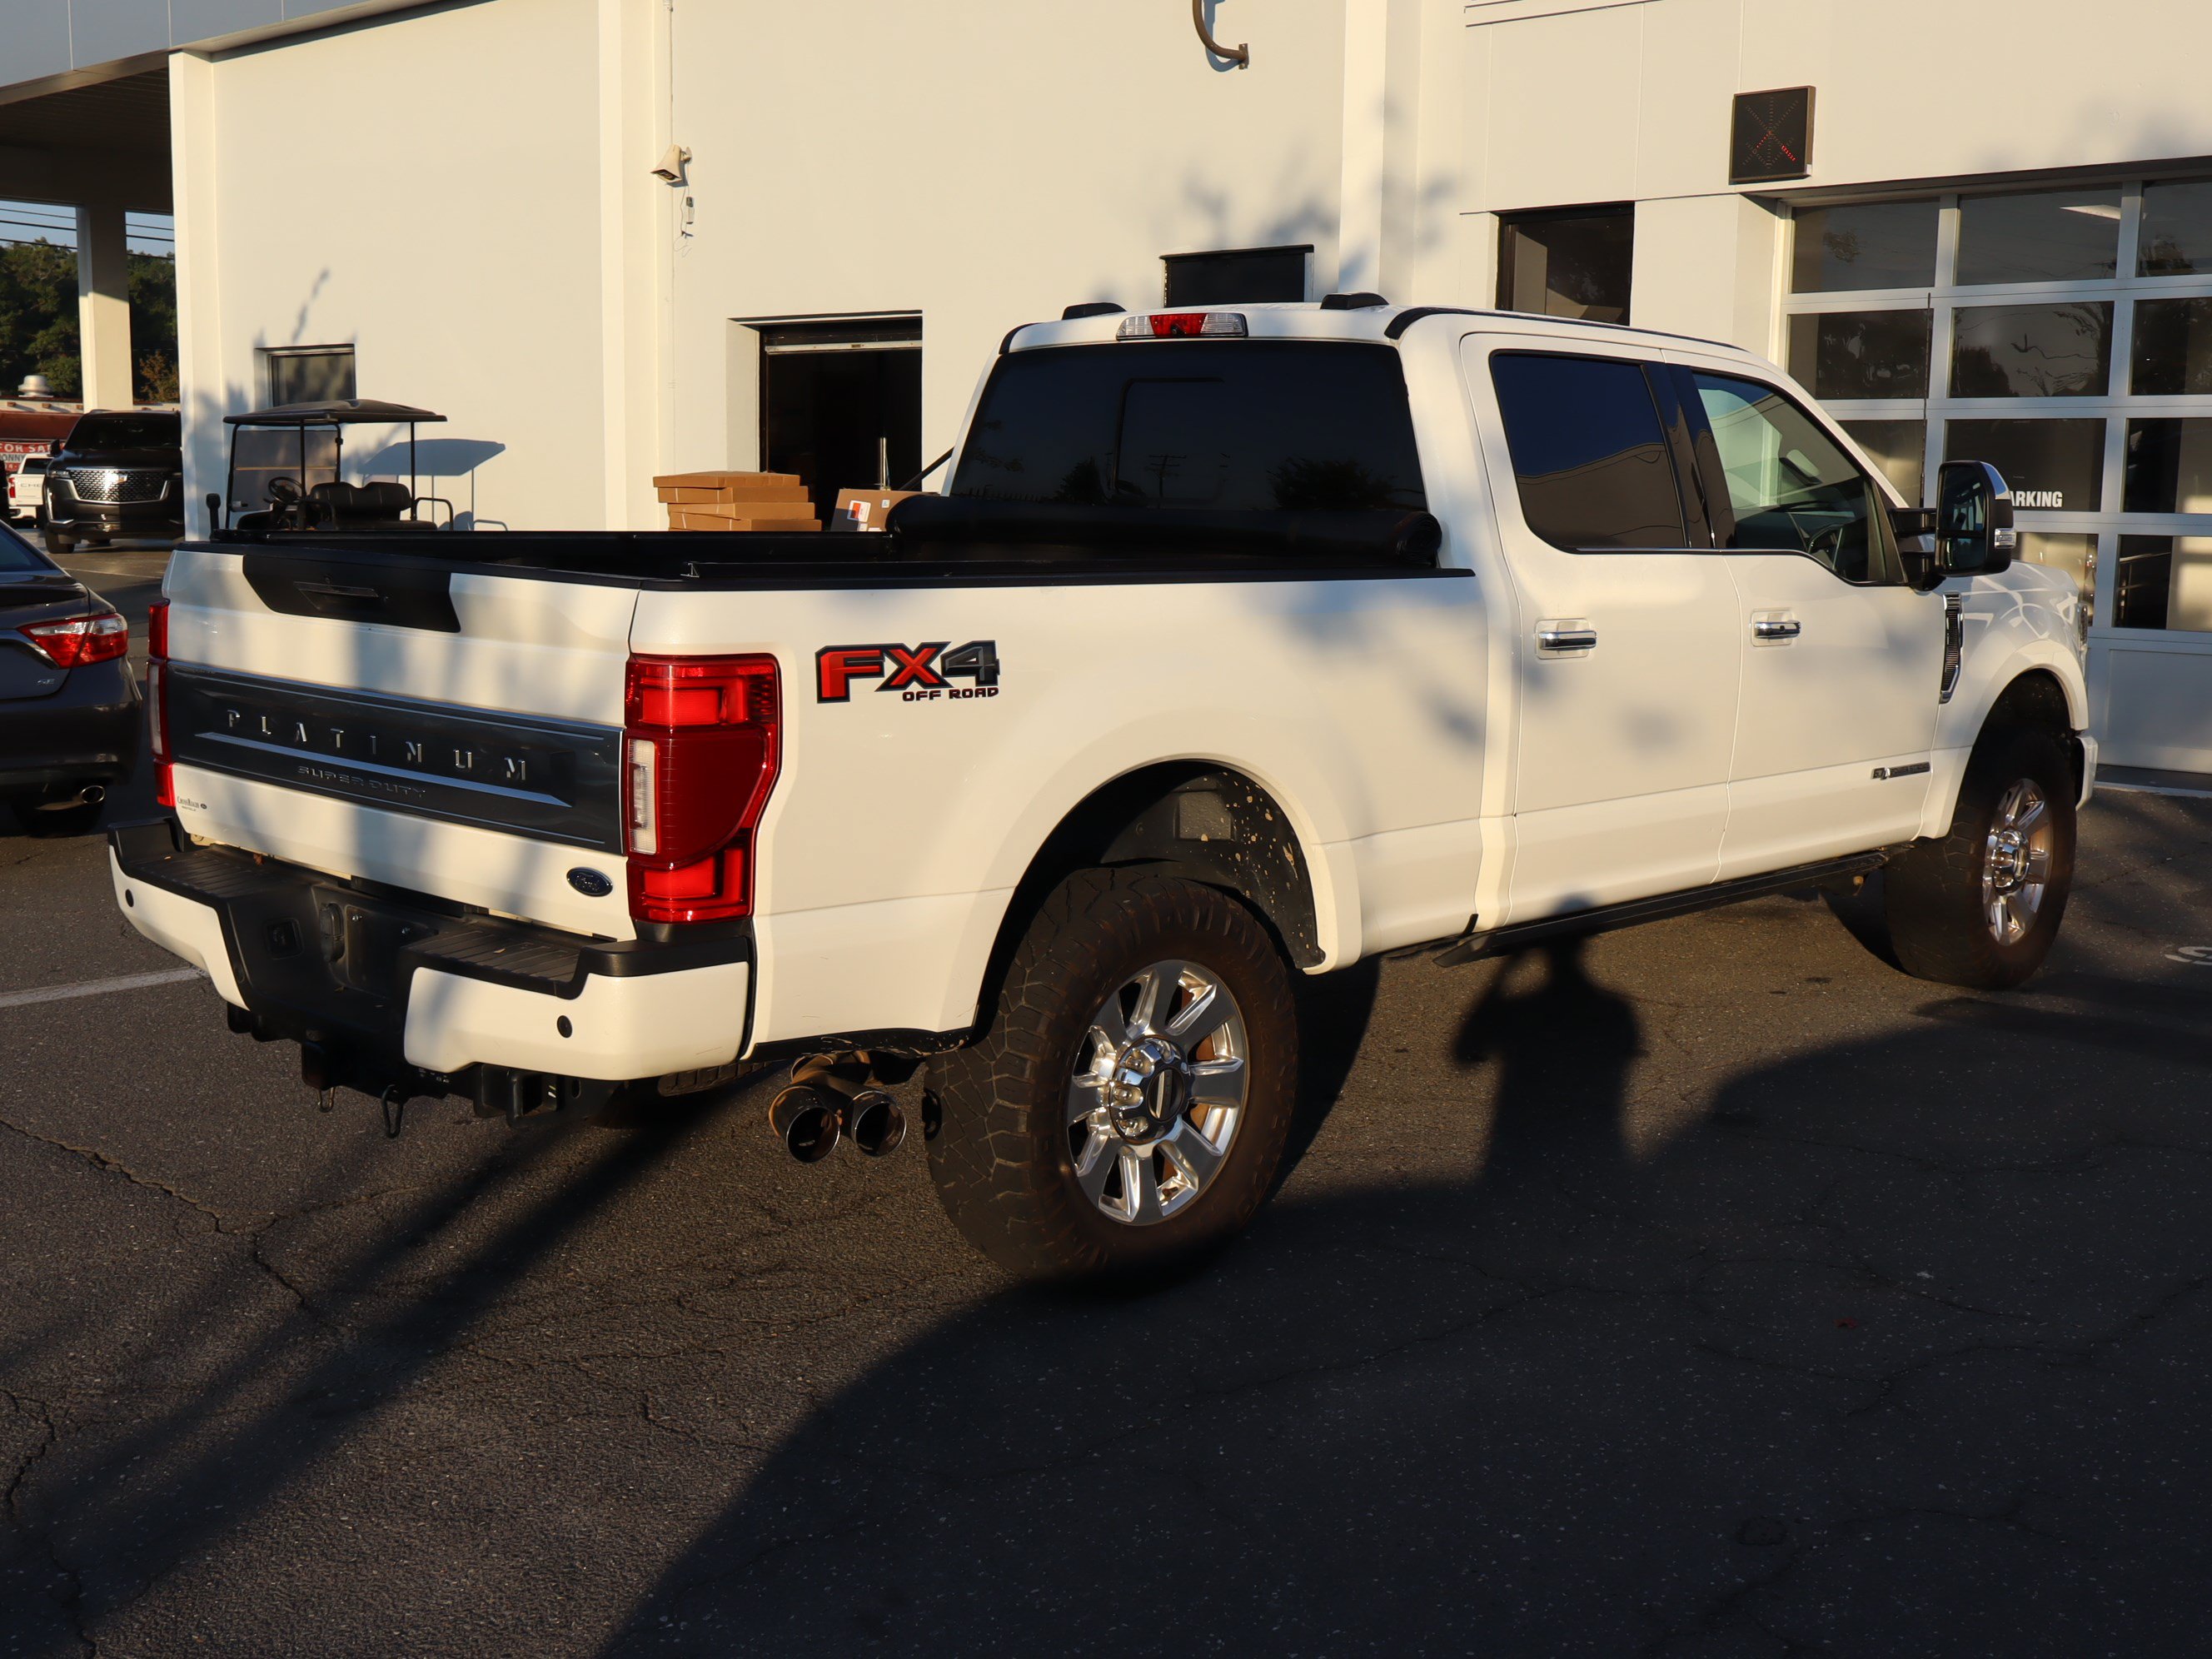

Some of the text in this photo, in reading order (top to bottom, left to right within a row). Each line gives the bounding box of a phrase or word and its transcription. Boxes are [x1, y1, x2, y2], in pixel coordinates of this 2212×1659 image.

[815, 640, 999, 704] FX4
[902, 687, 999, 701] OFF ROAD
[227, 709, 526, 781] PLATINUM
[297, 765, 426, 797] SUPER DUTY
